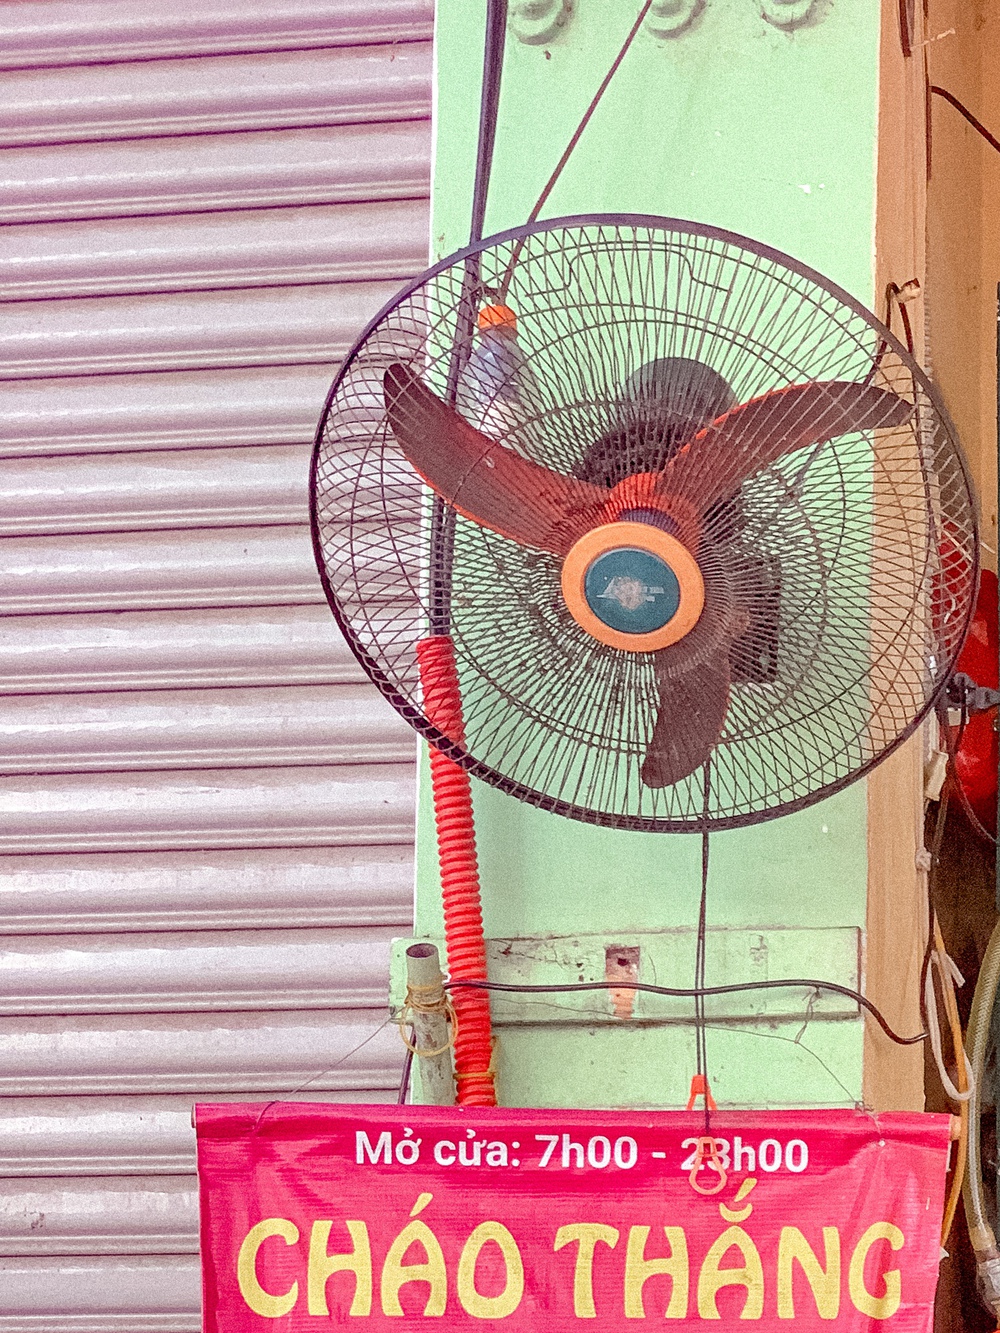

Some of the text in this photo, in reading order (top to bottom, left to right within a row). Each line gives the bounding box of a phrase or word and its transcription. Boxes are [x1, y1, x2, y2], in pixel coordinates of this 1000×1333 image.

[356, 1128, 421, 1164] Mở
[434, 1129, 519, 1166] cửa:
[536, 1134, 637, 1169] 7h00
[680, 1136, 809, 1172] 23h00
[238, 1178, 906, 1319] CHÁO THẮNG
